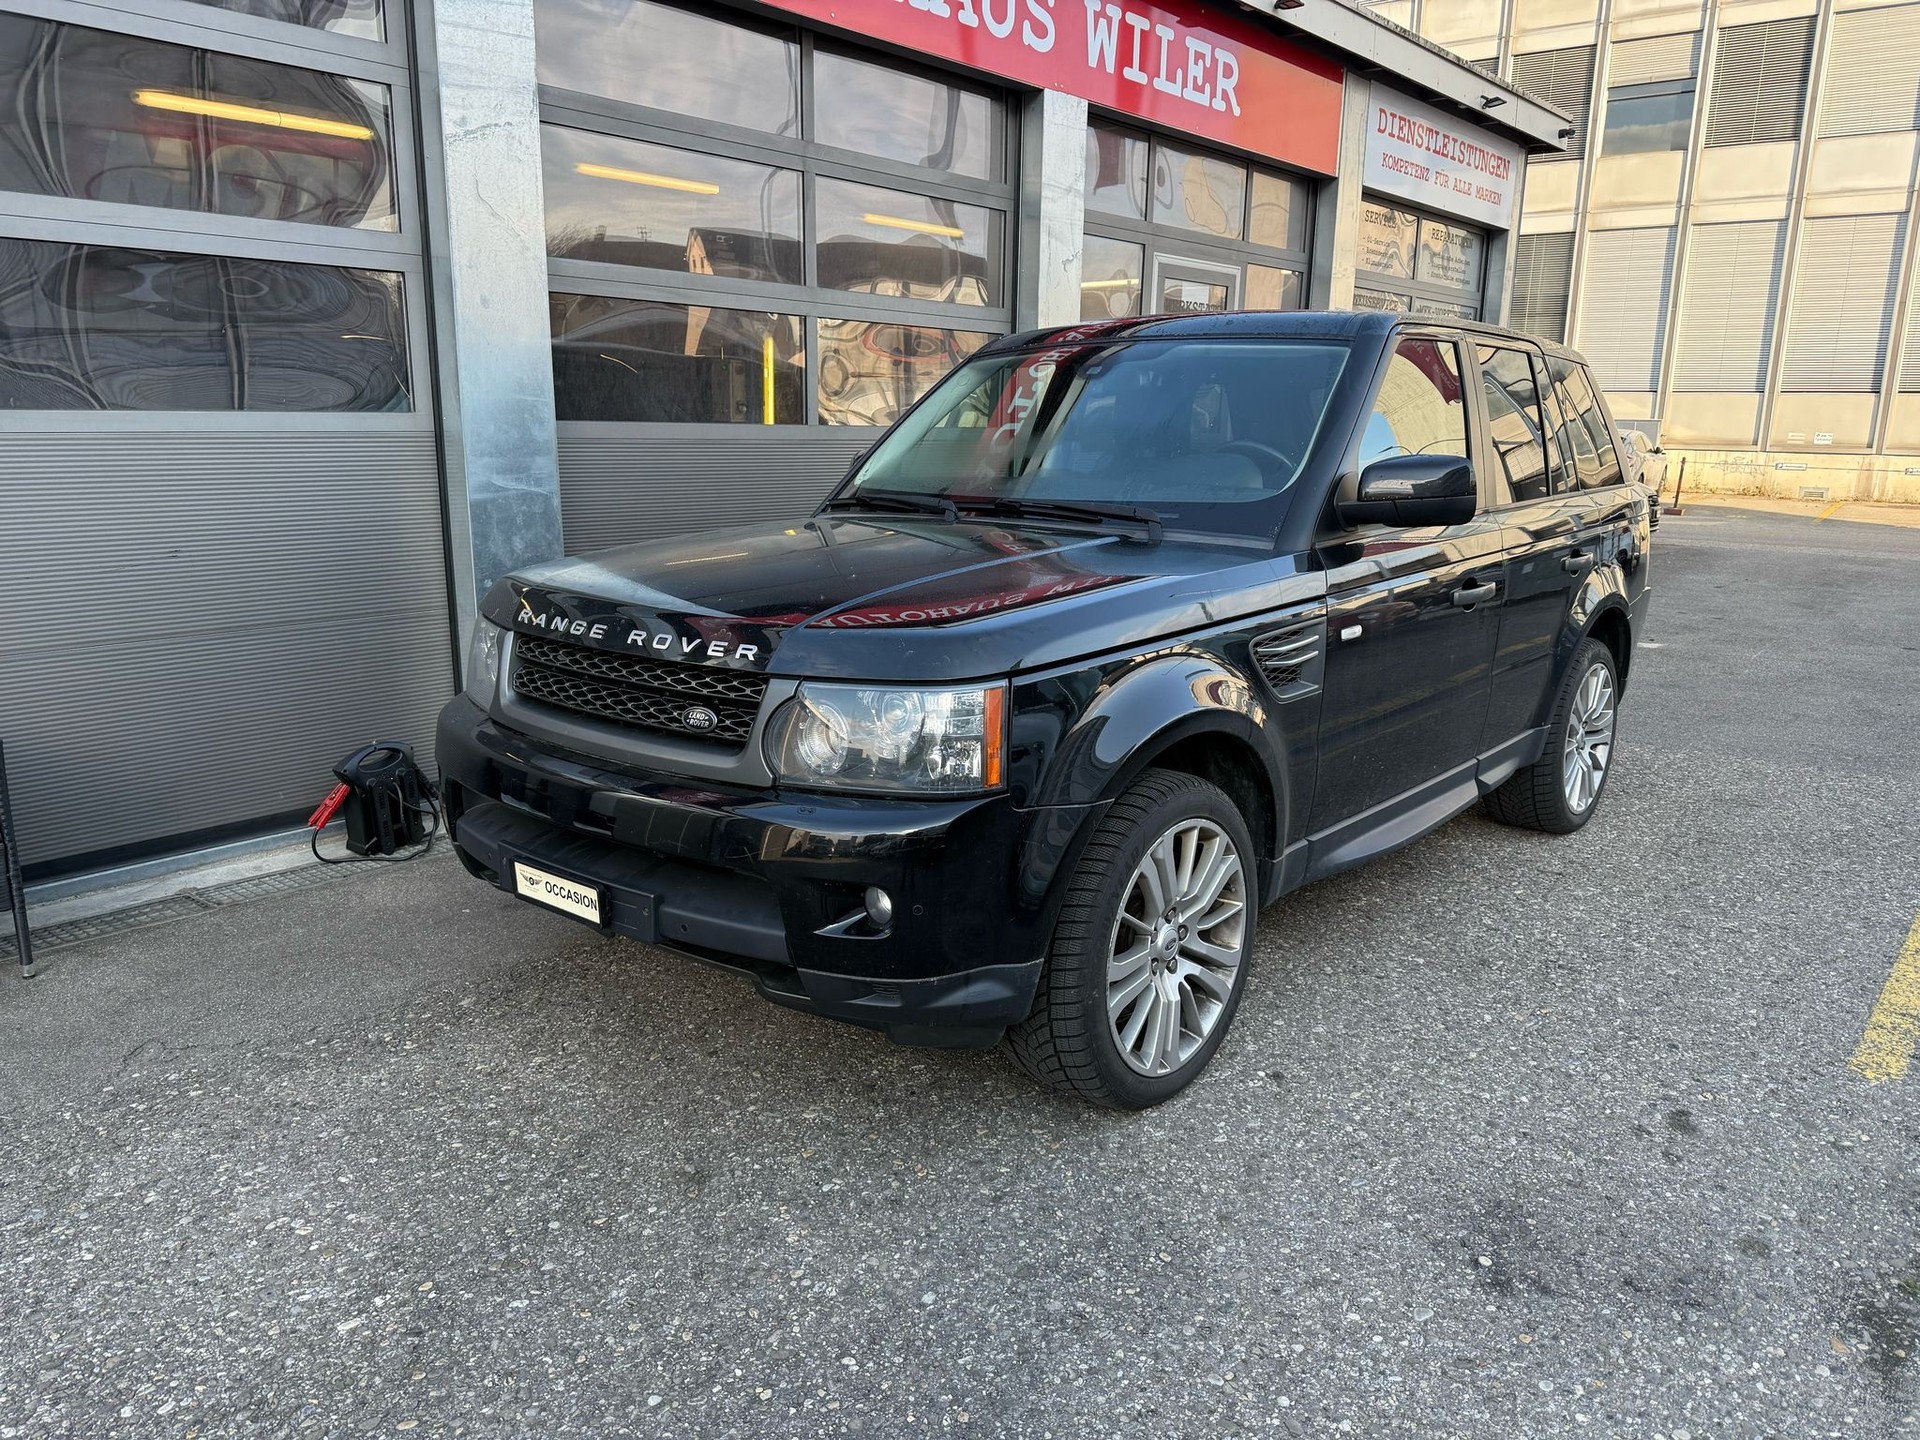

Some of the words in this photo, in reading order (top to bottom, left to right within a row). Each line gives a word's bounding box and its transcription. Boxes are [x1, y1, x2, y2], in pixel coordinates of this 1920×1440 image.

[1084, 0, 1241, 117] WILER
[1377, 107, 1511, 181] DIENSTLEISTUNGEN
[1381, 152, 1430, 182] KOMPETENZ
[1434, 168, 1450, 189] FÜR
[1452, 177, 1472, 196] ALLE
[1475, 184, 1502, 206] MARKEN
[517, 608, 608, 640] RANGE
[626, 628, 759, 661] ROVER
[688, 712, 706, 721] LAND
[689, 718, 710, 728] ROVER
[545, 881, 598, 911] OCCASION
